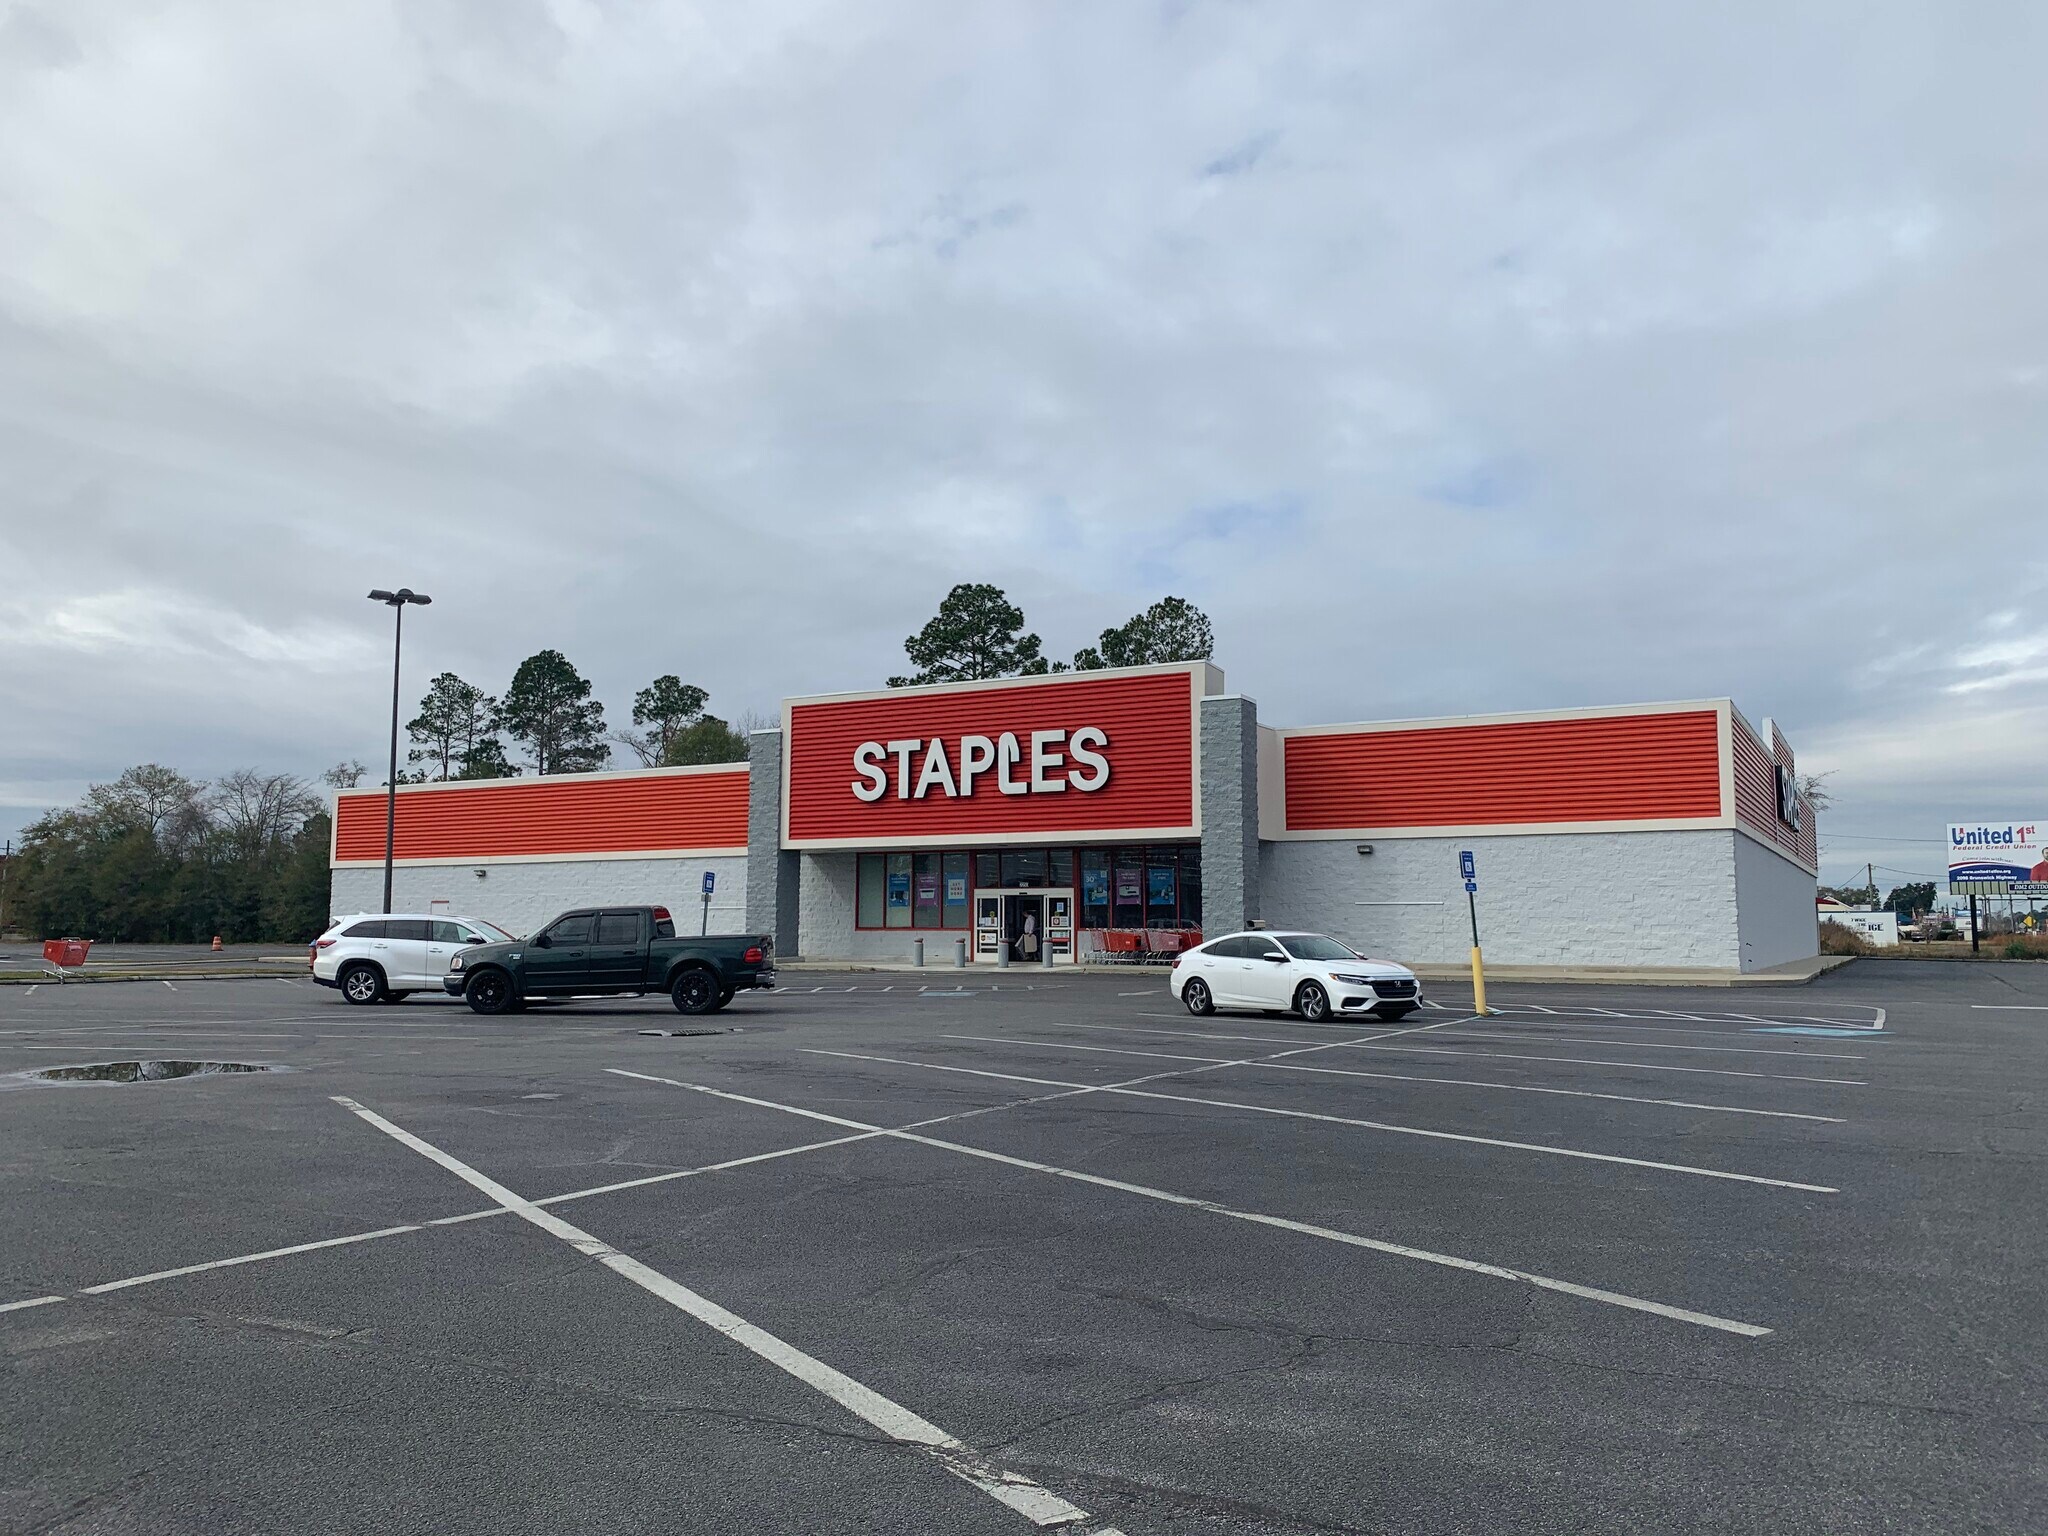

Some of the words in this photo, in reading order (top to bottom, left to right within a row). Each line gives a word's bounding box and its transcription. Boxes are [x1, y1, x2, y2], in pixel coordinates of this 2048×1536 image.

[851, 726, 1109, 802] STAPLES
[1952, 826, 2012, 845] United
[2016, 825, 2036, 843] 1st
[1868, 922, 1884, 931] ICE
